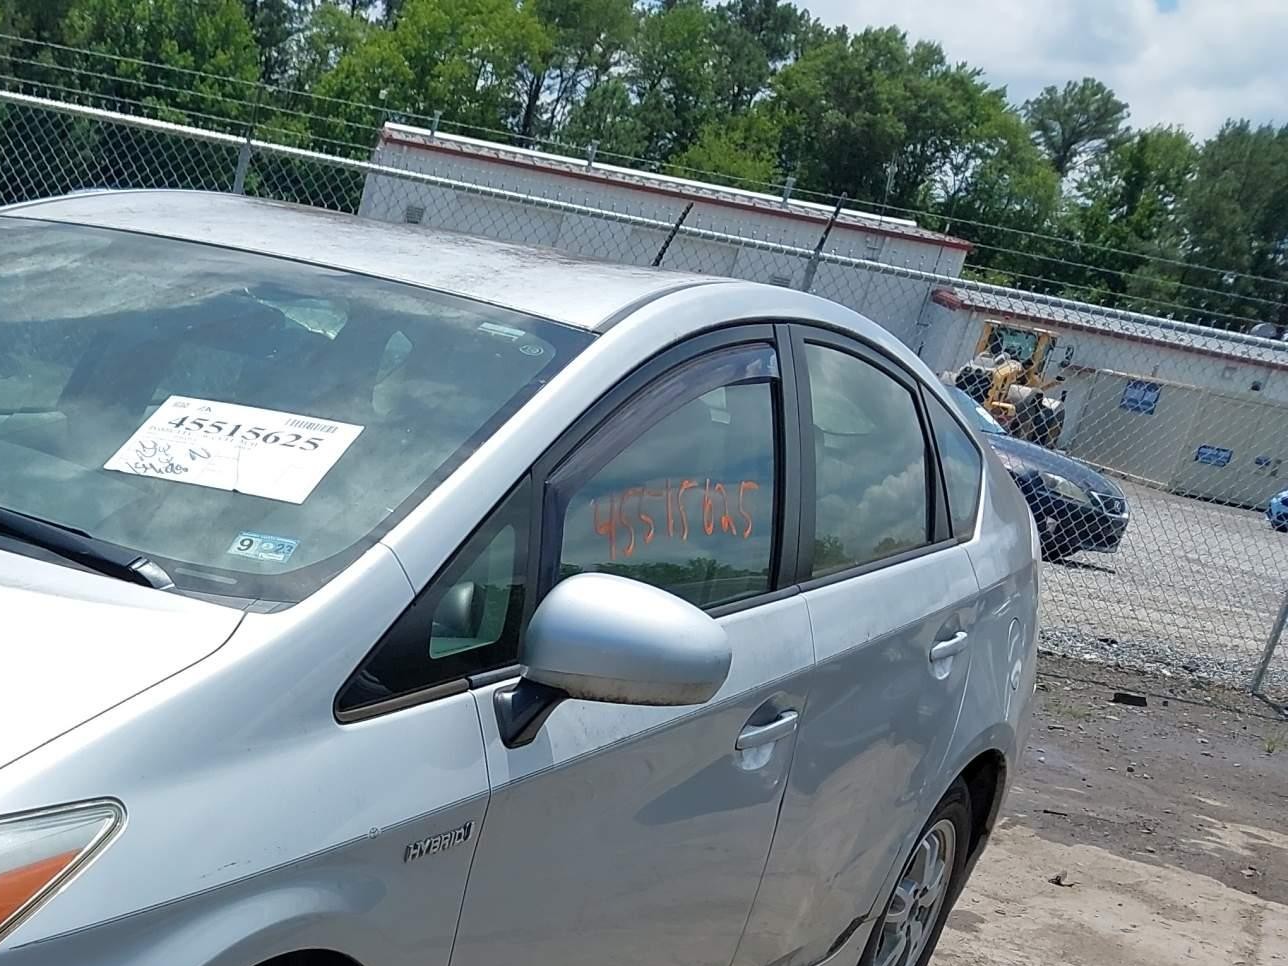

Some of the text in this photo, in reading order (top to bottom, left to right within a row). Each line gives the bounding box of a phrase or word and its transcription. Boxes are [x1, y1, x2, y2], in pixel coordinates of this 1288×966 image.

[168, 415, 326, 452] 45515625
[593, 478, 760, 560] 45515625
[237, 538, 254, 552] 9
[405, 824, 471, 861] HYBRID
